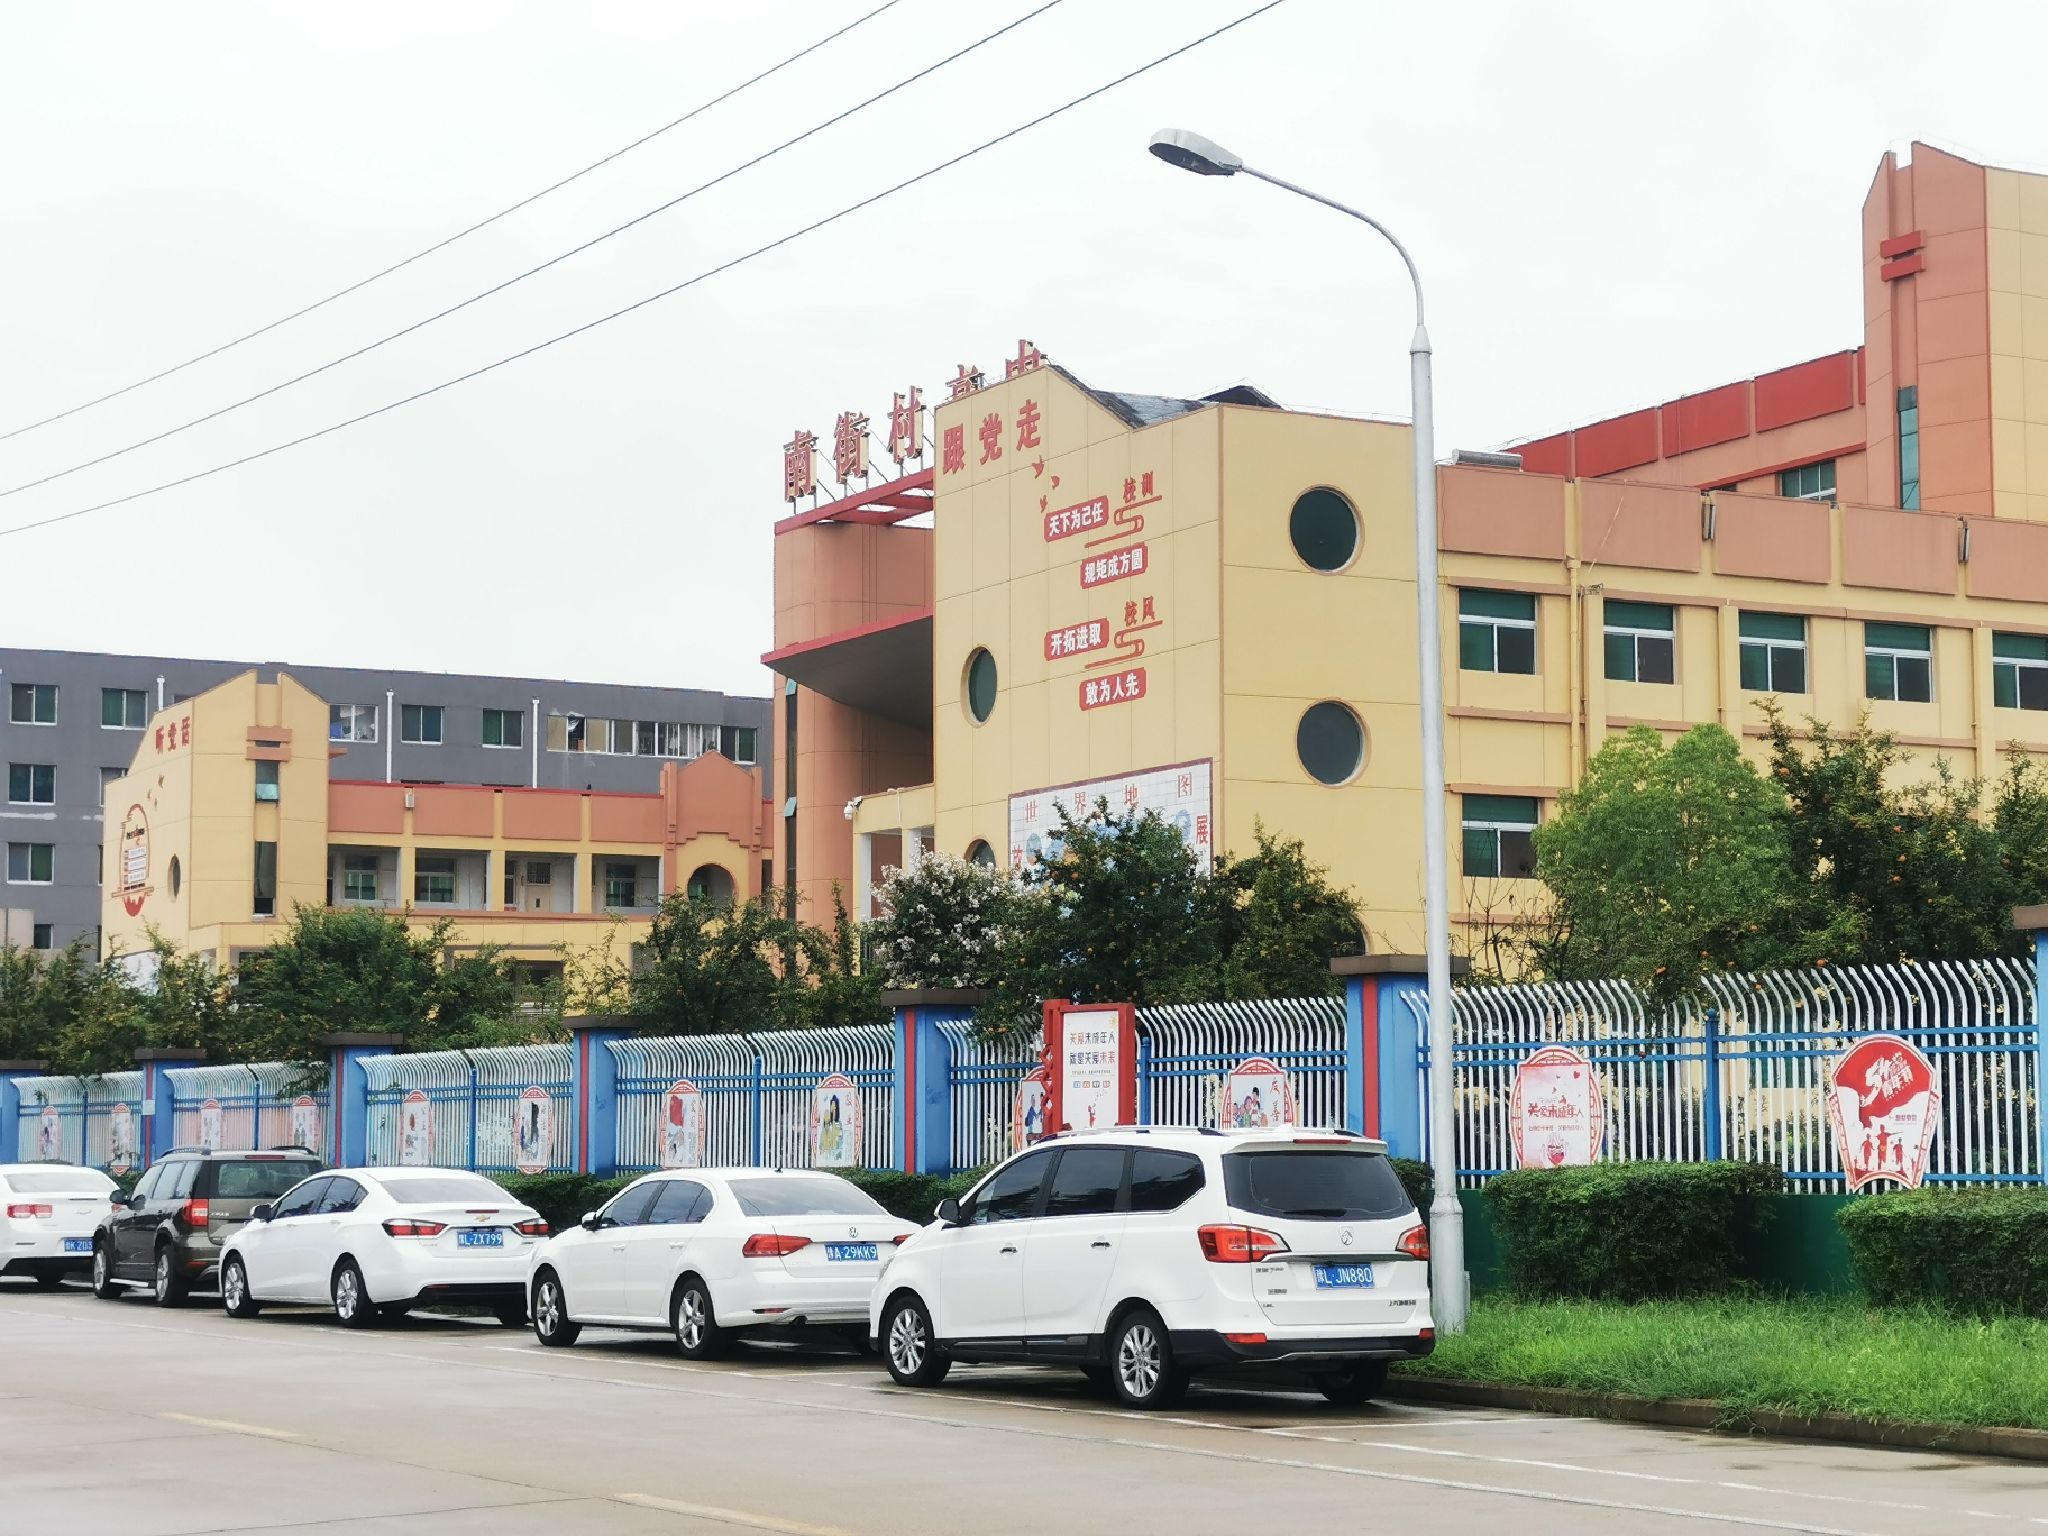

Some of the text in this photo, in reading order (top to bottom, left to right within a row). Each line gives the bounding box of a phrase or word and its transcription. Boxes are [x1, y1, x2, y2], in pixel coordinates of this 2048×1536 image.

[942, 399, 1042, 476] 跟党走
[1049, 501, 1104, 537] 天下为己任
[1124, 596, 1156, 627] 校风
[1050, 622, 1102, 656] 开拓进取
[1085, 672, 1140, 705] 敢为人先
